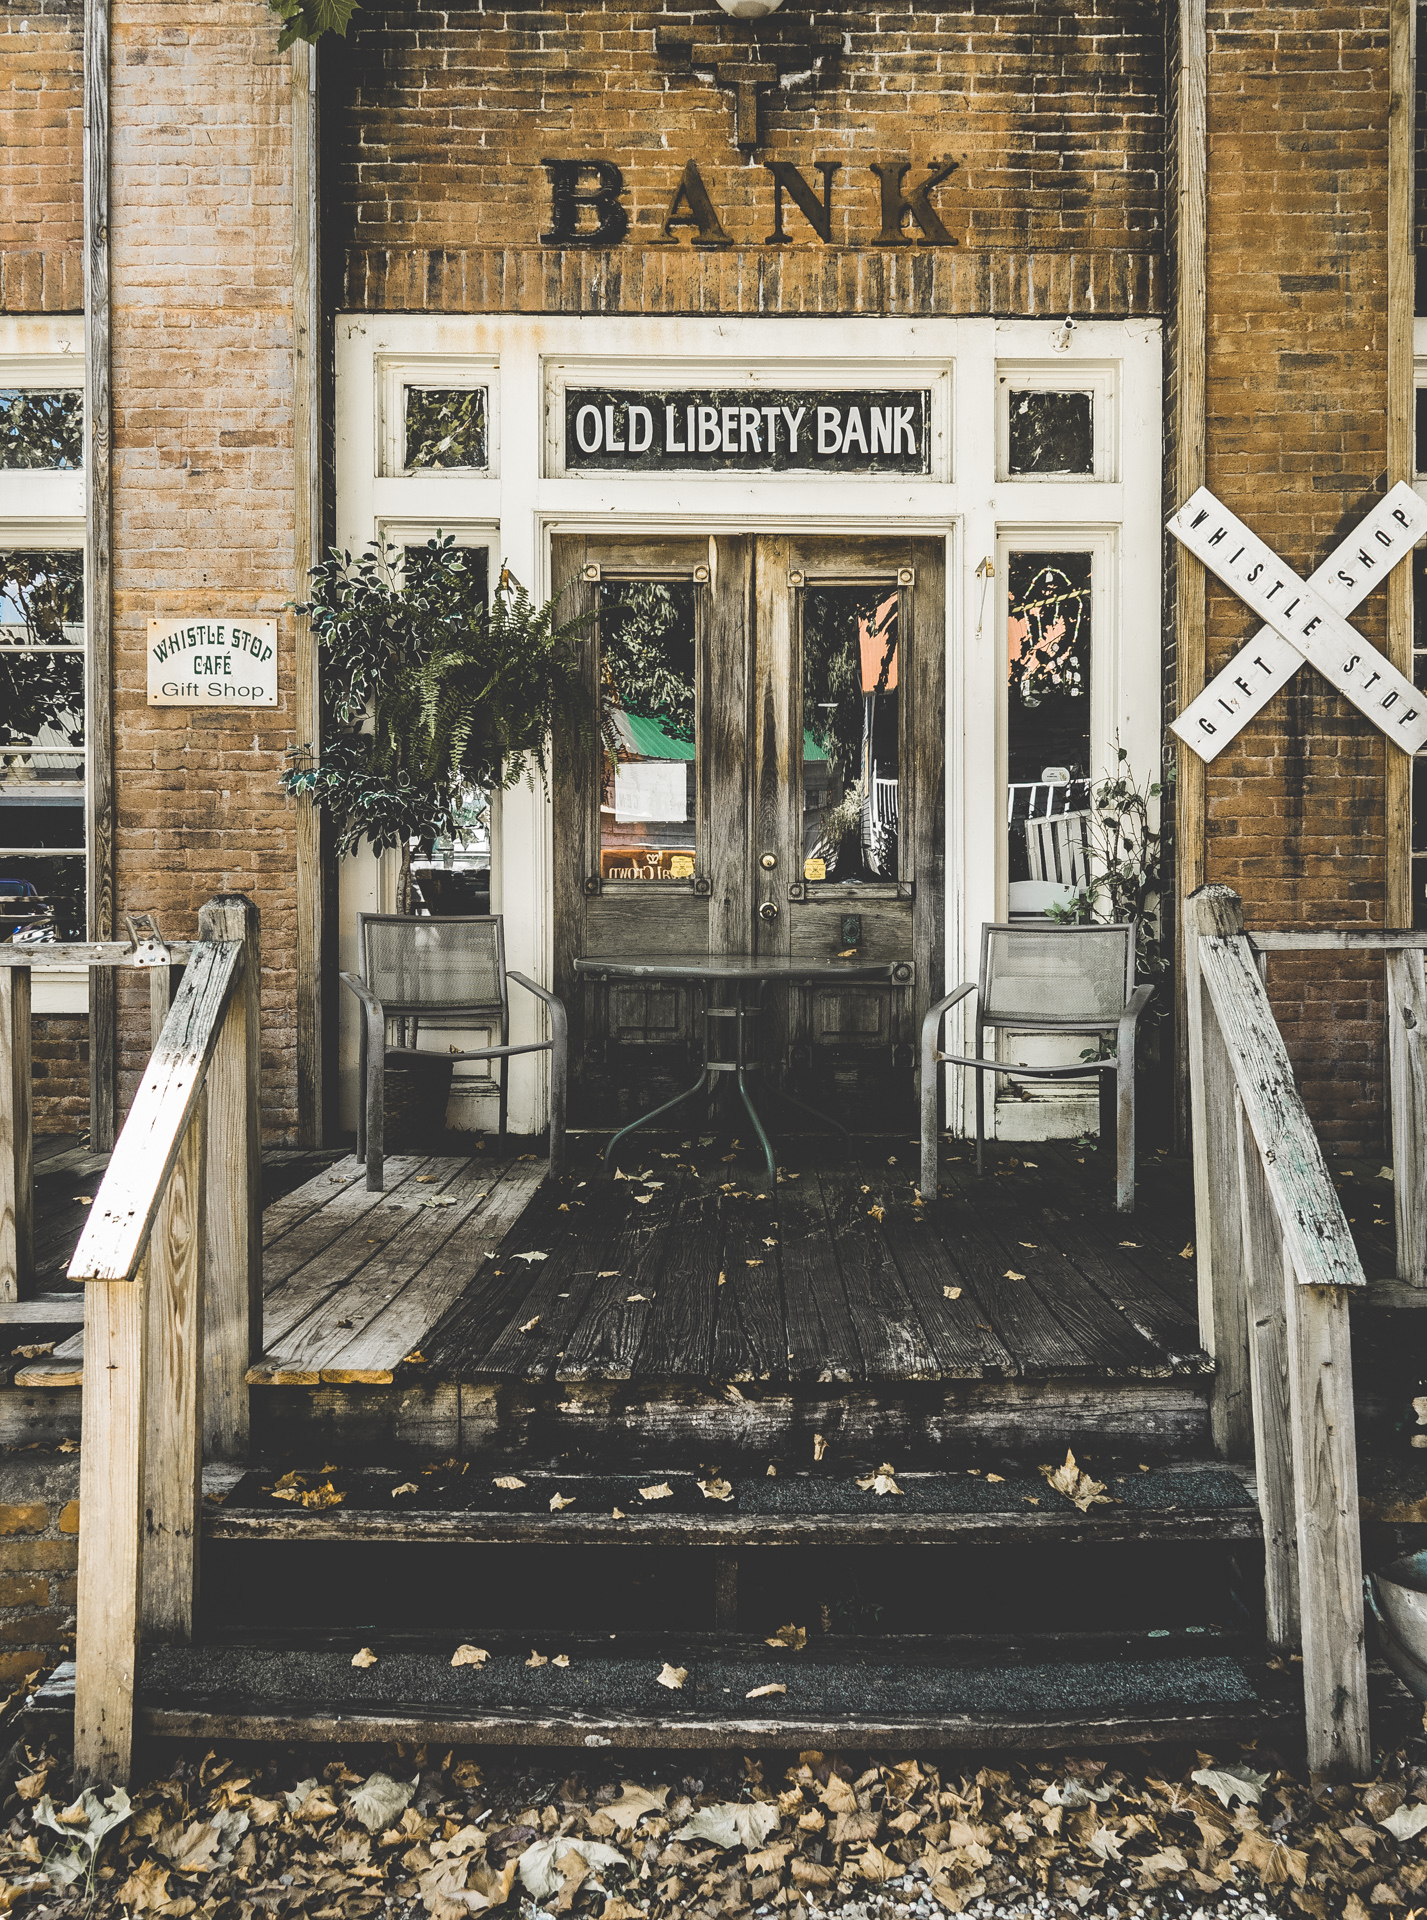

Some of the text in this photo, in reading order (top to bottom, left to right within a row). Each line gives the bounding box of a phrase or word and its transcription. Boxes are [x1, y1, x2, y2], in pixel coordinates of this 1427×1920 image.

[540, 158, 959, 246] BANK
[575, 404, 917, 455] OLD LIBERTY BANK
[1190, 508, 1419, 726] WHISTLE STOP
[1198, 508, 1413, 735] GIFT SHOP
[152, 625, 273, 664] WHISTLE STOP
[194, 651, 232, 675] CAFÉ
[161, 682, 264, 700] Gift Shop
